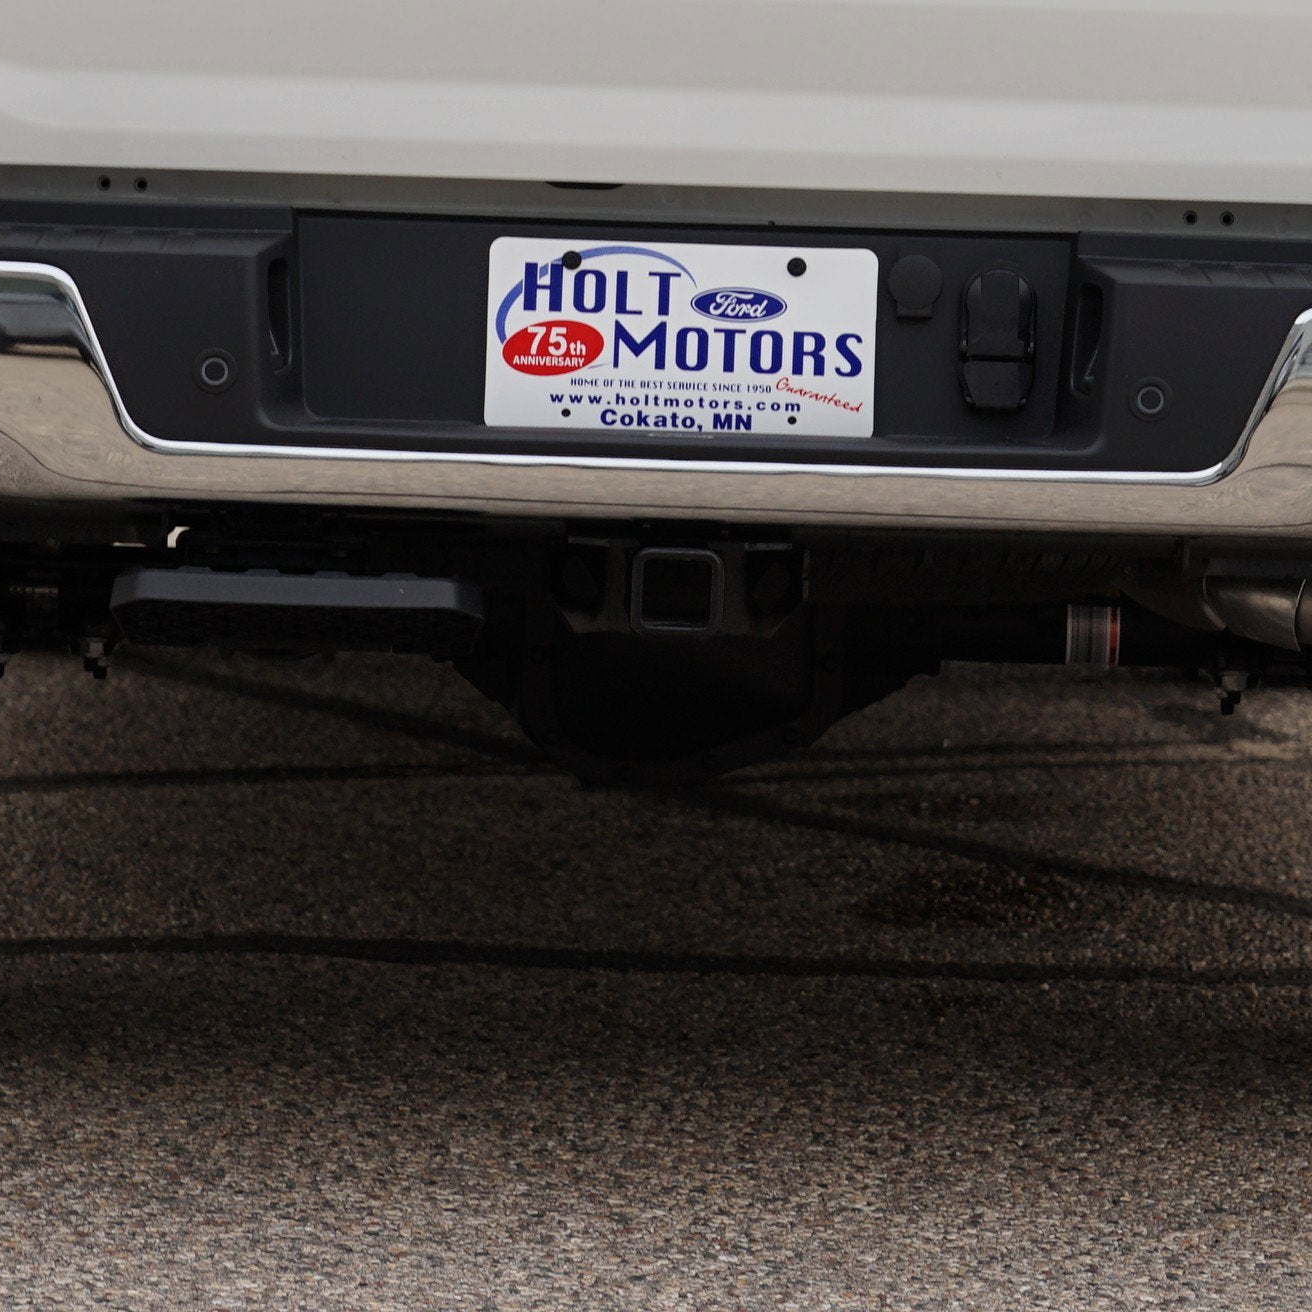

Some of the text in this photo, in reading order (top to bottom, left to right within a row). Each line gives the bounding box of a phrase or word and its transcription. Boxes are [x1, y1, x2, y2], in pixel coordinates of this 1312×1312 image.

[523, 261, 682, 316] HOLT
[709, 290, 769, 319] Ford
[526, 325, 587, 357] 75th
[613, 319, 863, 378] MOTORS
[512, 355, 585, 368] ANNIVERSARY
[570, 377, 772, 394] HOME OF THE BEST SERVICE SINCE 1950
[775, 376, 864, 414] Guaranteed
[549, 393, 801, 413] www.holtmotors.com
[600, 408, 752, 432] Cokato, MN
